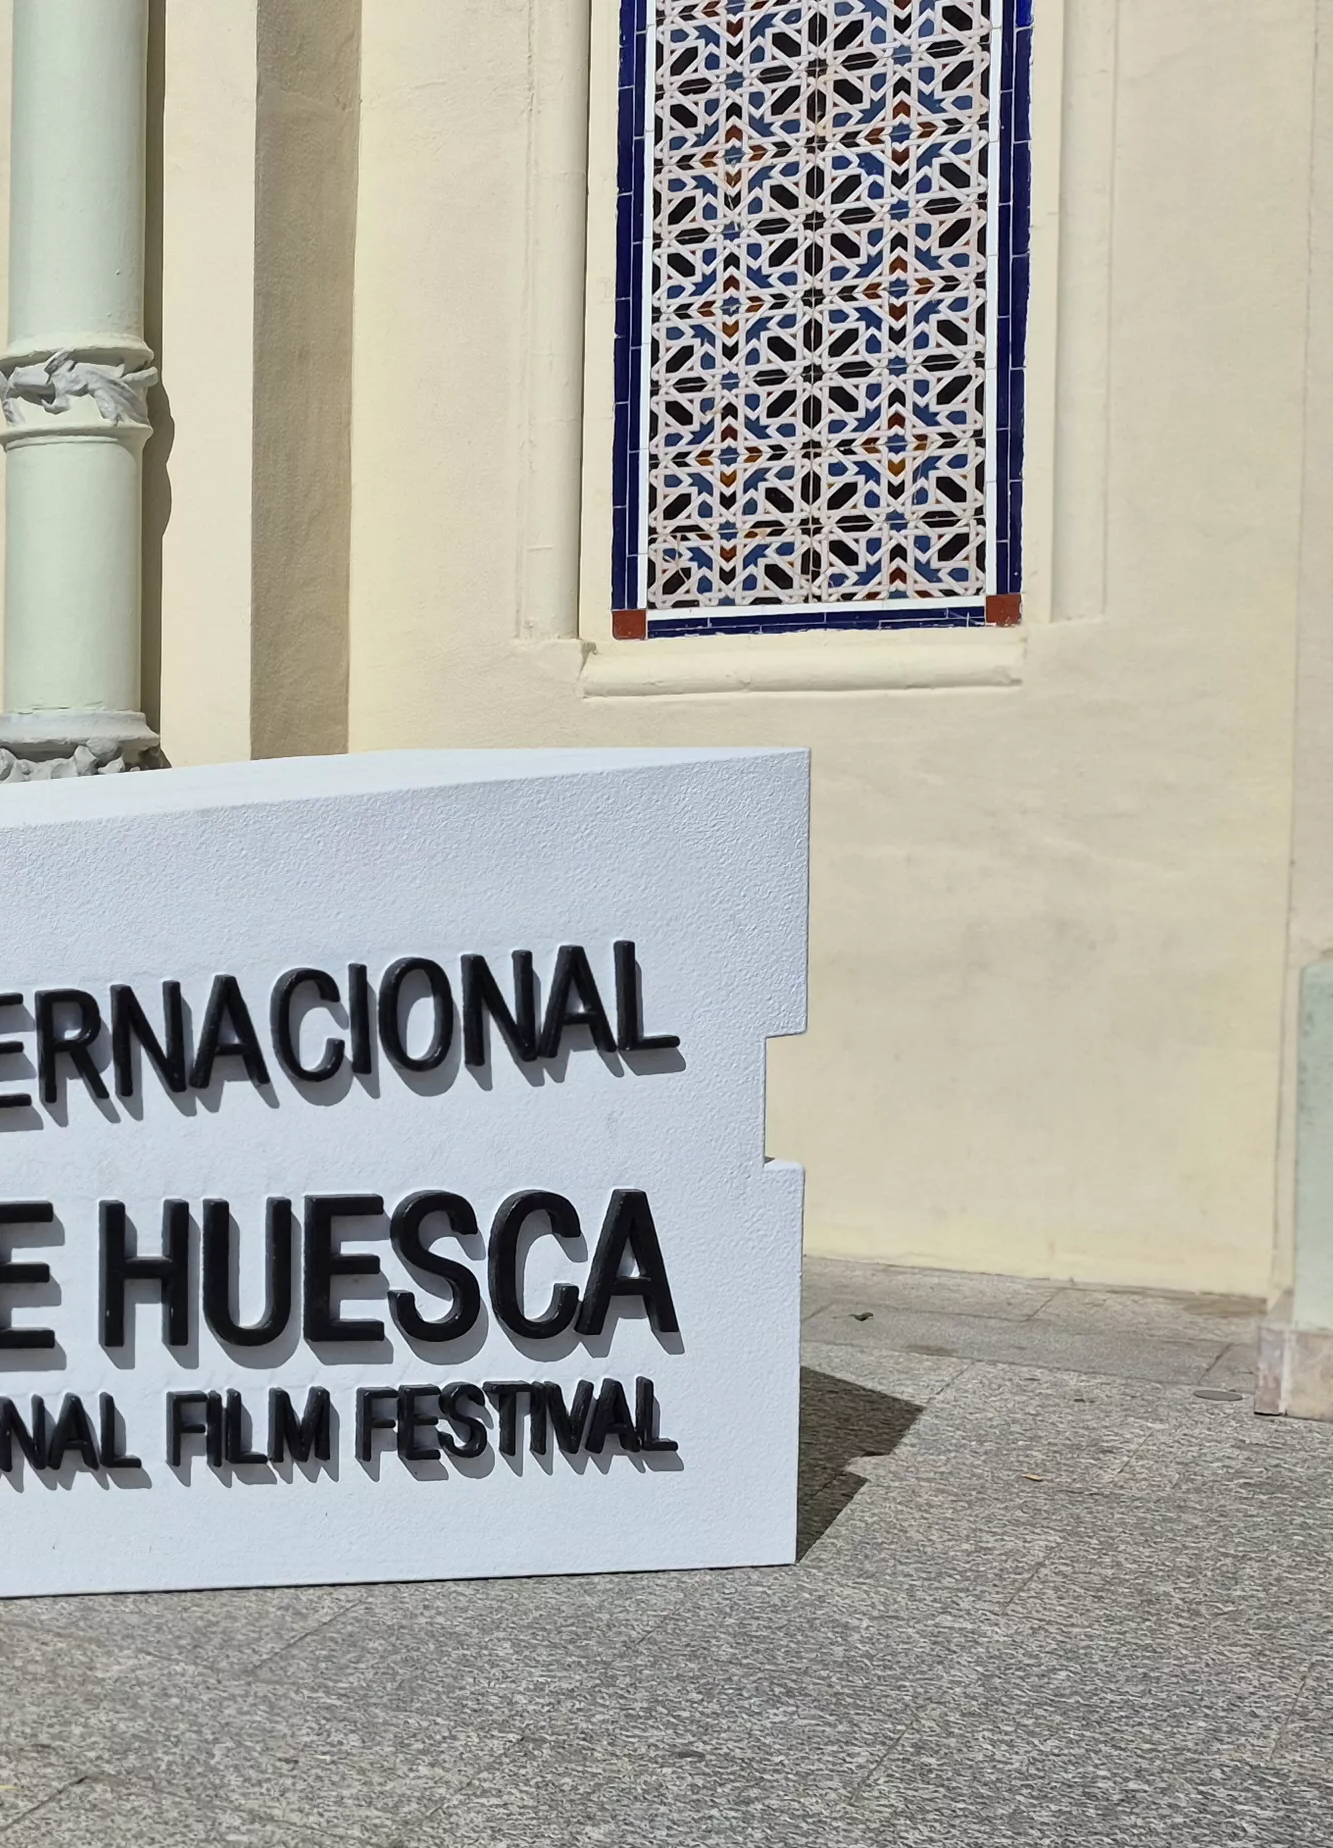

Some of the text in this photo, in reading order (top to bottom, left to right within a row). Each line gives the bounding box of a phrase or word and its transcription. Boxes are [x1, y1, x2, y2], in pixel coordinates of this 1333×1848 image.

[99, 1189, 680, 1347] HUESCA
[166, 1386, 331, 1467] FILM
[355, 1376, 679, 1461] FESTIVAL
